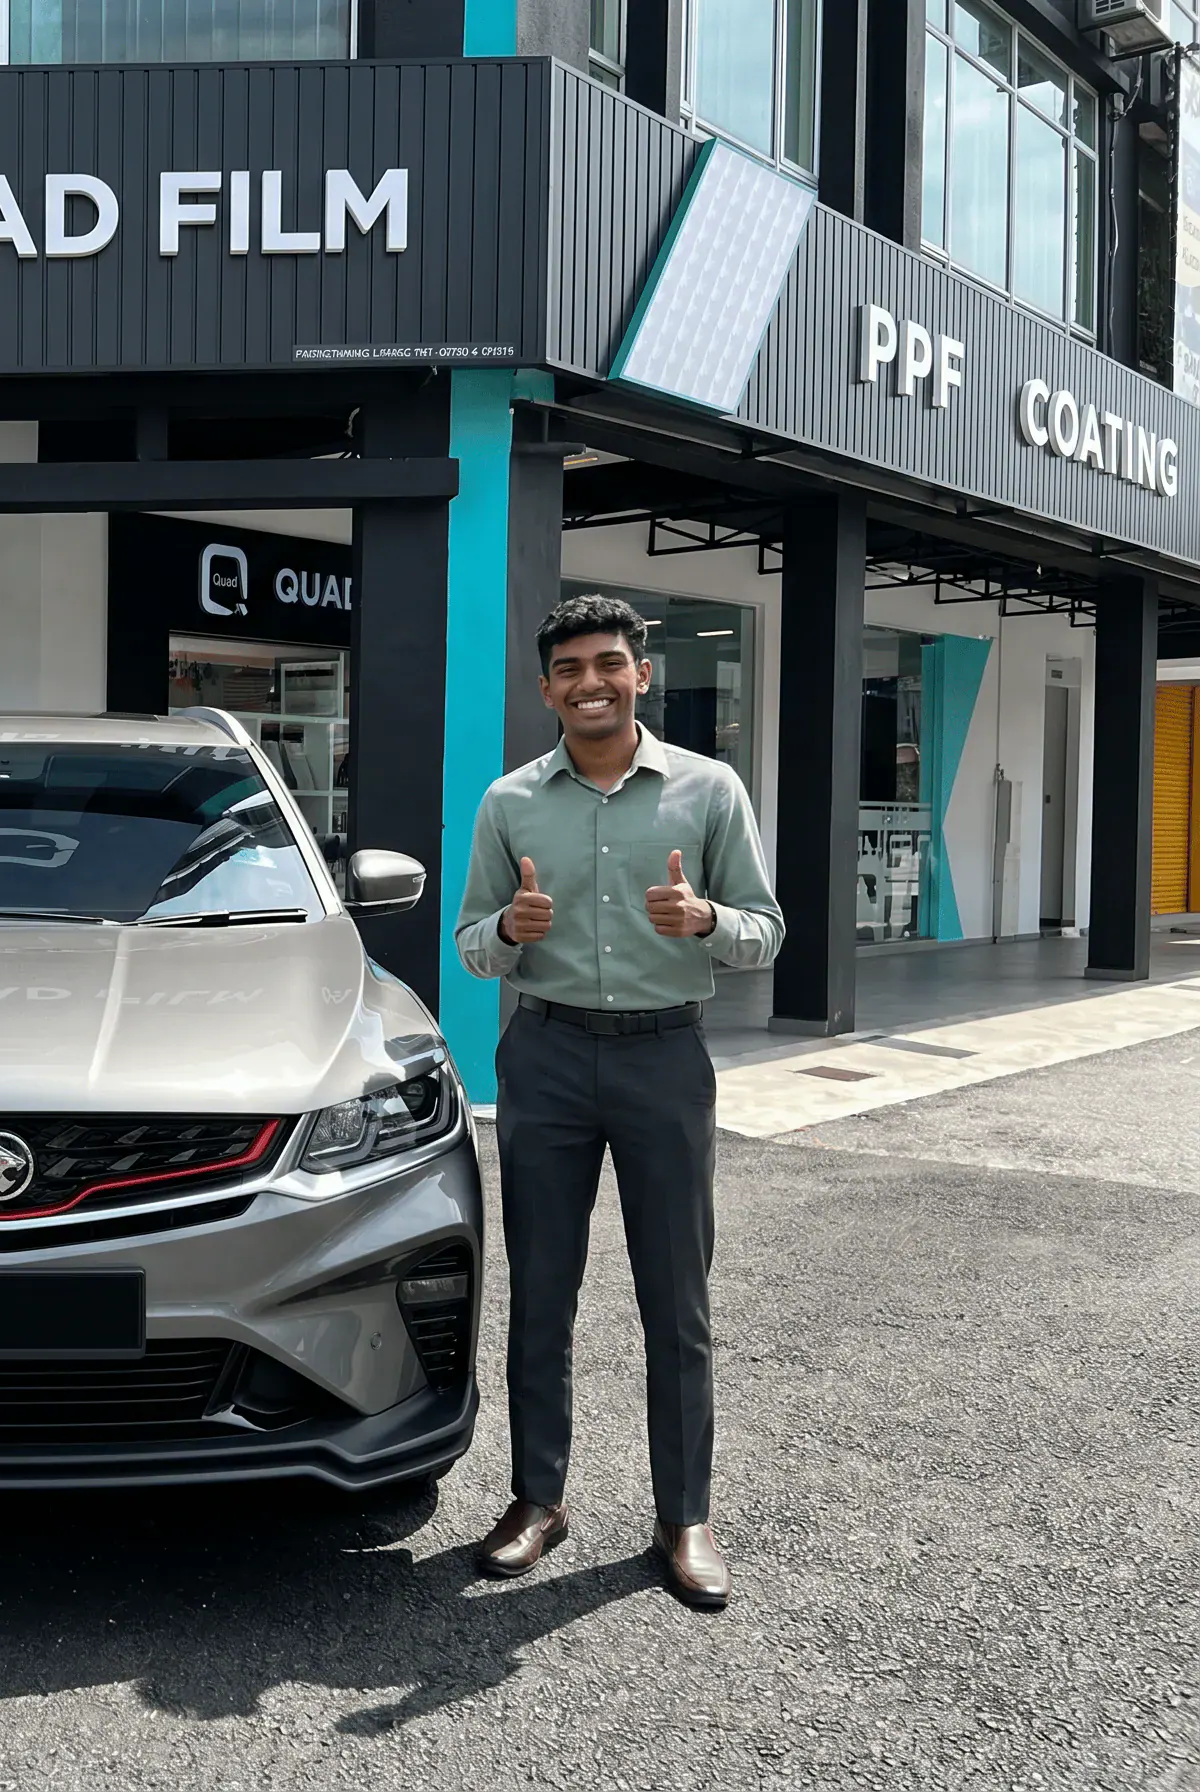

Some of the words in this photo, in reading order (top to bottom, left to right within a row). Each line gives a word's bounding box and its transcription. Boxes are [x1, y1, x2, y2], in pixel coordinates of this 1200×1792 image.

[159, 168, 409, 256] FILM
[859, 304, 964, 409] PPF
[1020, 378, 1178, 498] COATING
[212, 573, 238, 588] Quad
